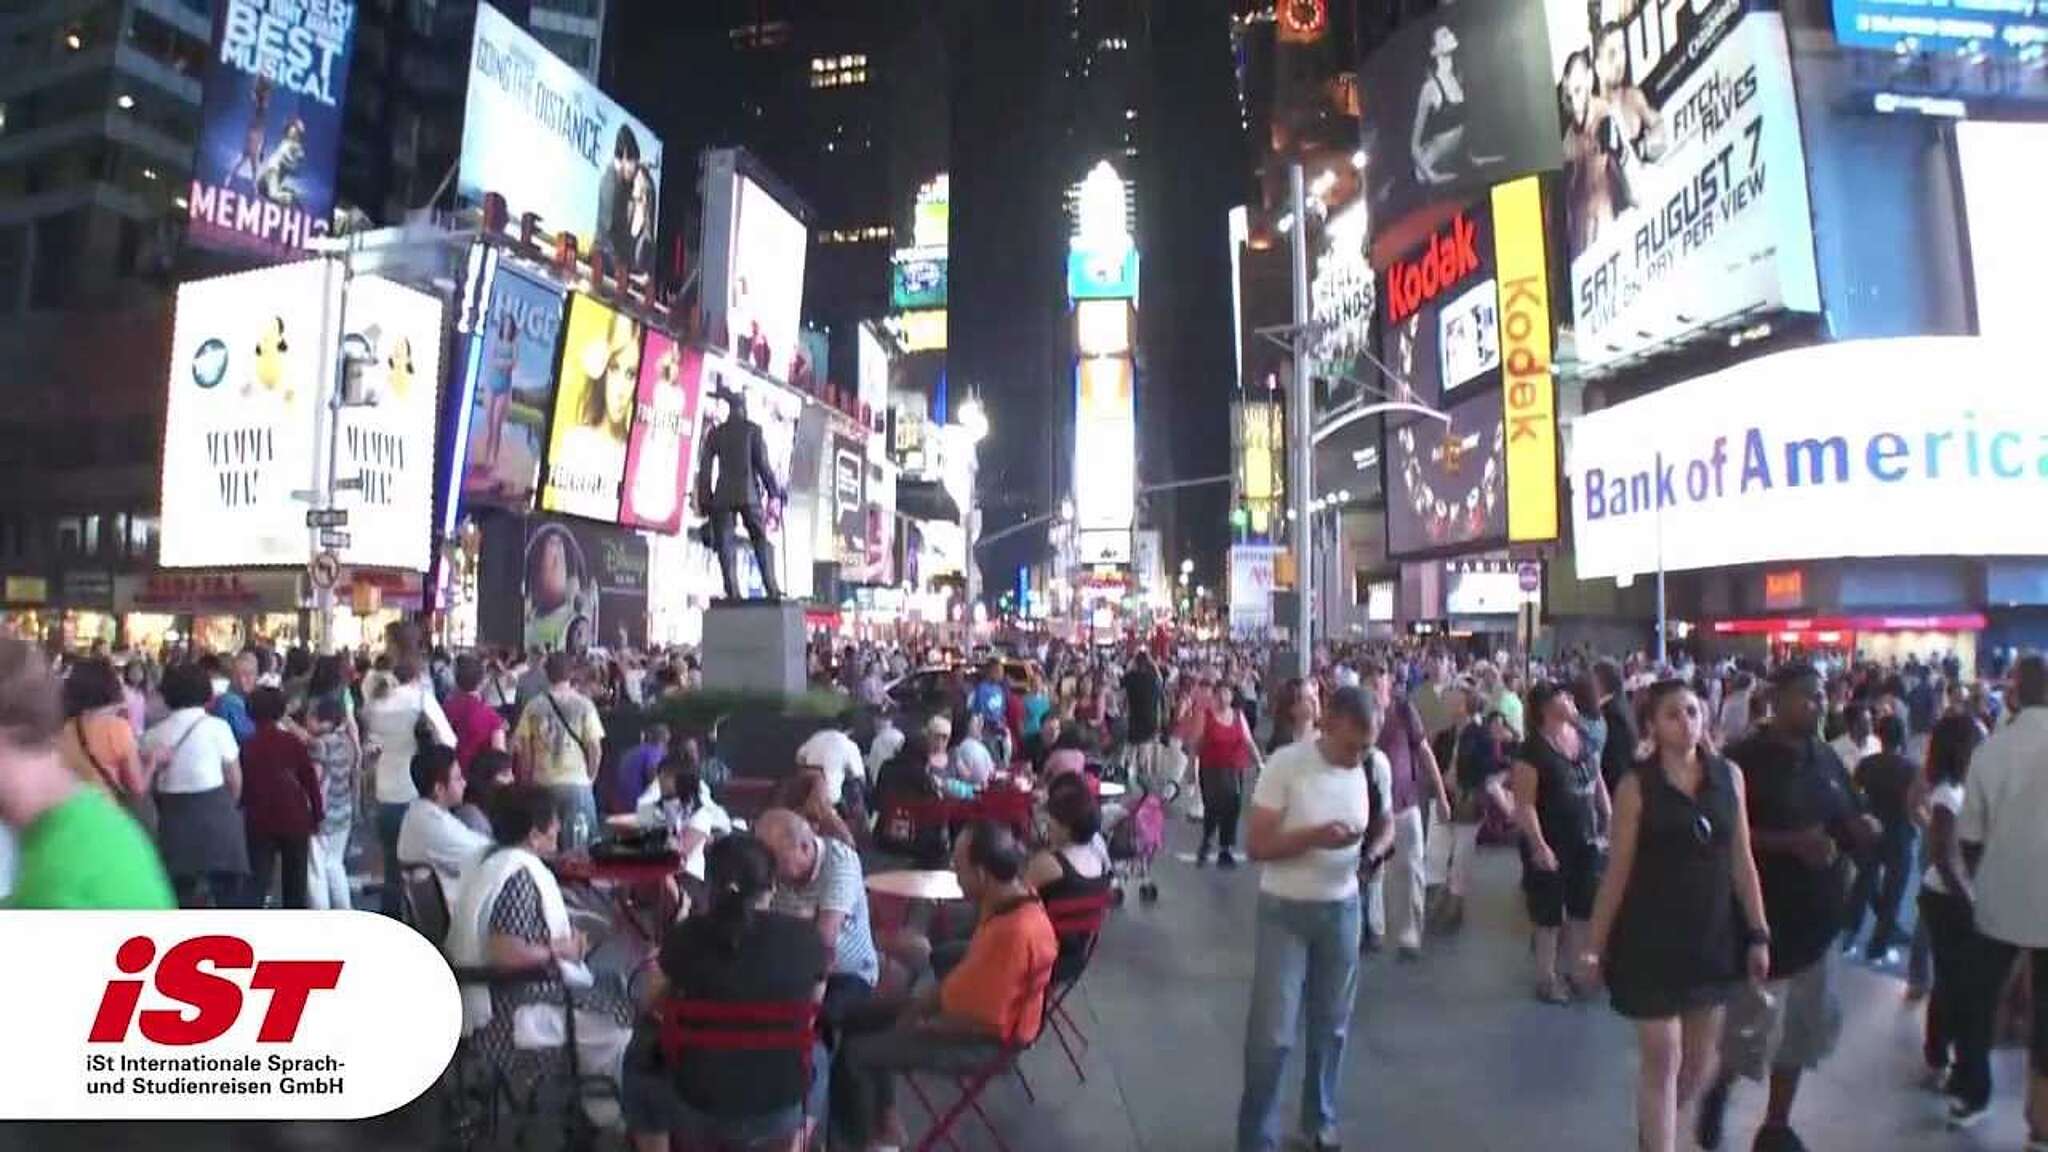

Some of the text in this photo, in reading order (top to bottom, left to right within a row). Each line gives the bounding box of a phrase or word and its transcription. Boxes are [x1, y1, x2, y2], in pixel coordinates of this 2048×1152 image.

[221, 40, 336, 106] MUSICAL
[224, 6, 344, 78] BEST
[535, 81, 602, 168] DISTANCE
[1673, 69, 1721, 141] FITCH
[1701, 64, 1757, 143] ALVES
[1581, 114, 1763, 318] SAT AUGUST 7
[1683, 211, 1715, 256] PER
[1720, 163, 1767, 222] VIEW
[1387, 214, 1479, 323] Kodak
[1504, 275, 1548, 443] Kodak
[207, 427, 272, 469] MAMMA
[346, 424, 404, 471] MAMMA
[1586, 451, 1677, 521] Bank
[1687, 436, 1727, 502] of
[219, 468, 259, 508] MIA!
